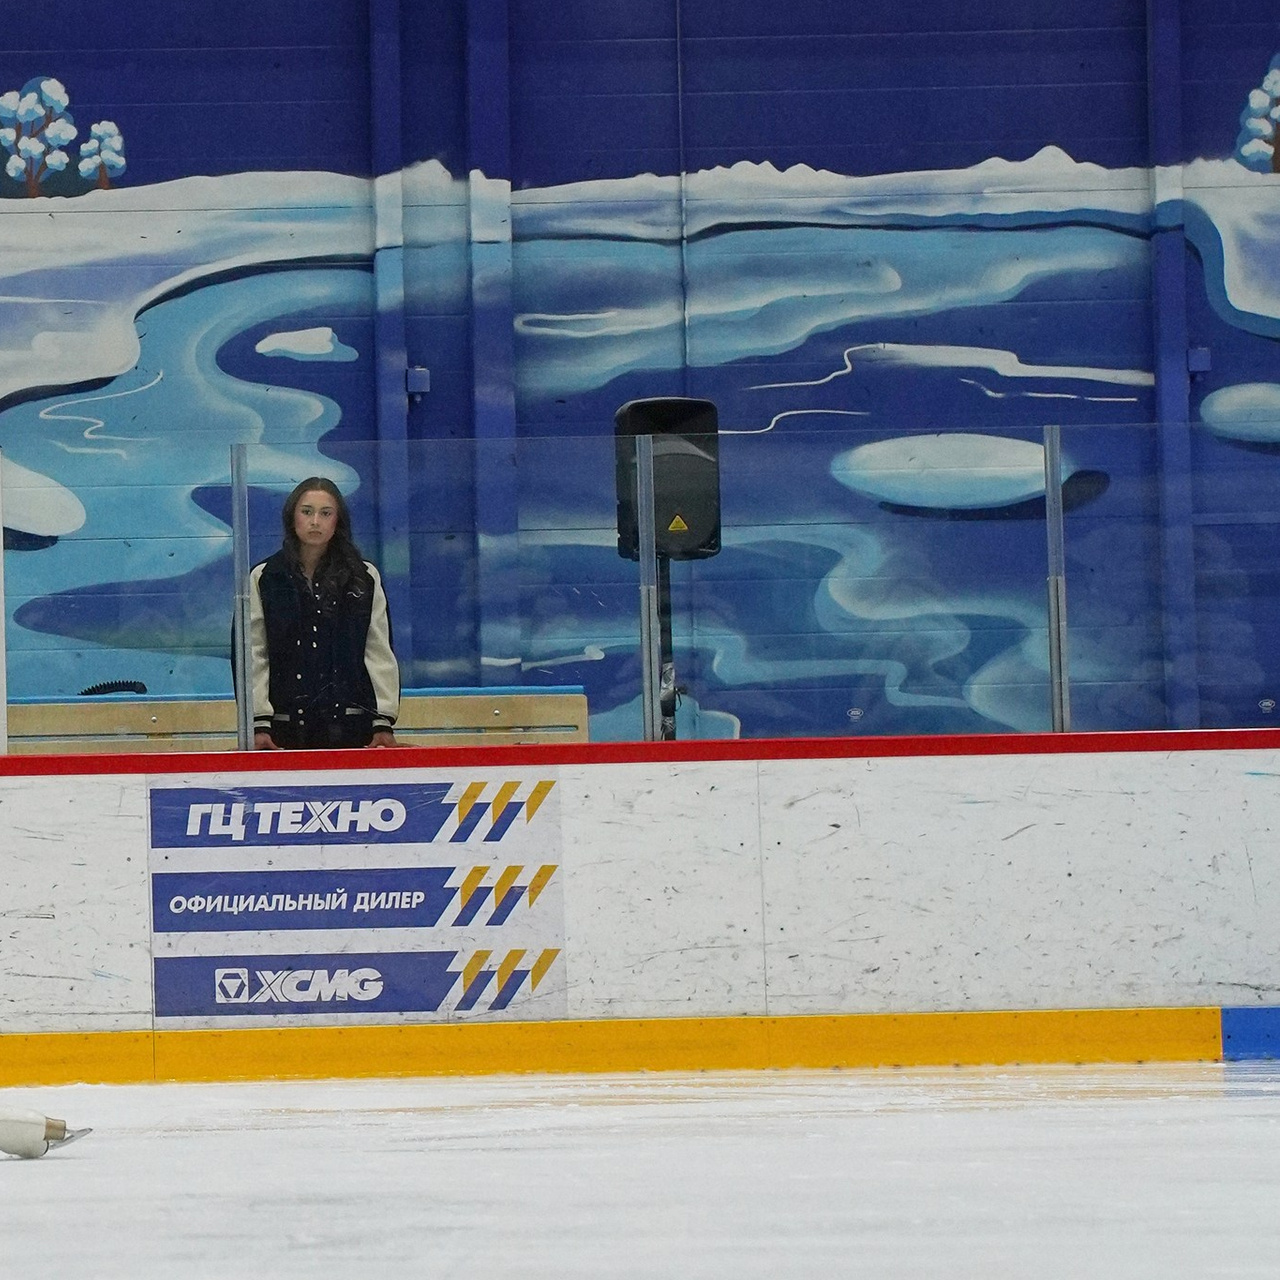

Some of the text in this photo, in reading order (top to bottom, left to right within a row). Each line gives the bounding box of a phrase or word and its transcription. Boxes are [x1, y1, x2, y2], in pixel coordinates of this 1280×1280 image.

[186, 798, 406, 841] ГЦ ТЕХНО
[169, 888, 425, 915] ОФИЦИАЛЬНЫЙ ДИЛЕР
[248, 967, 384, 1003] XCMG
